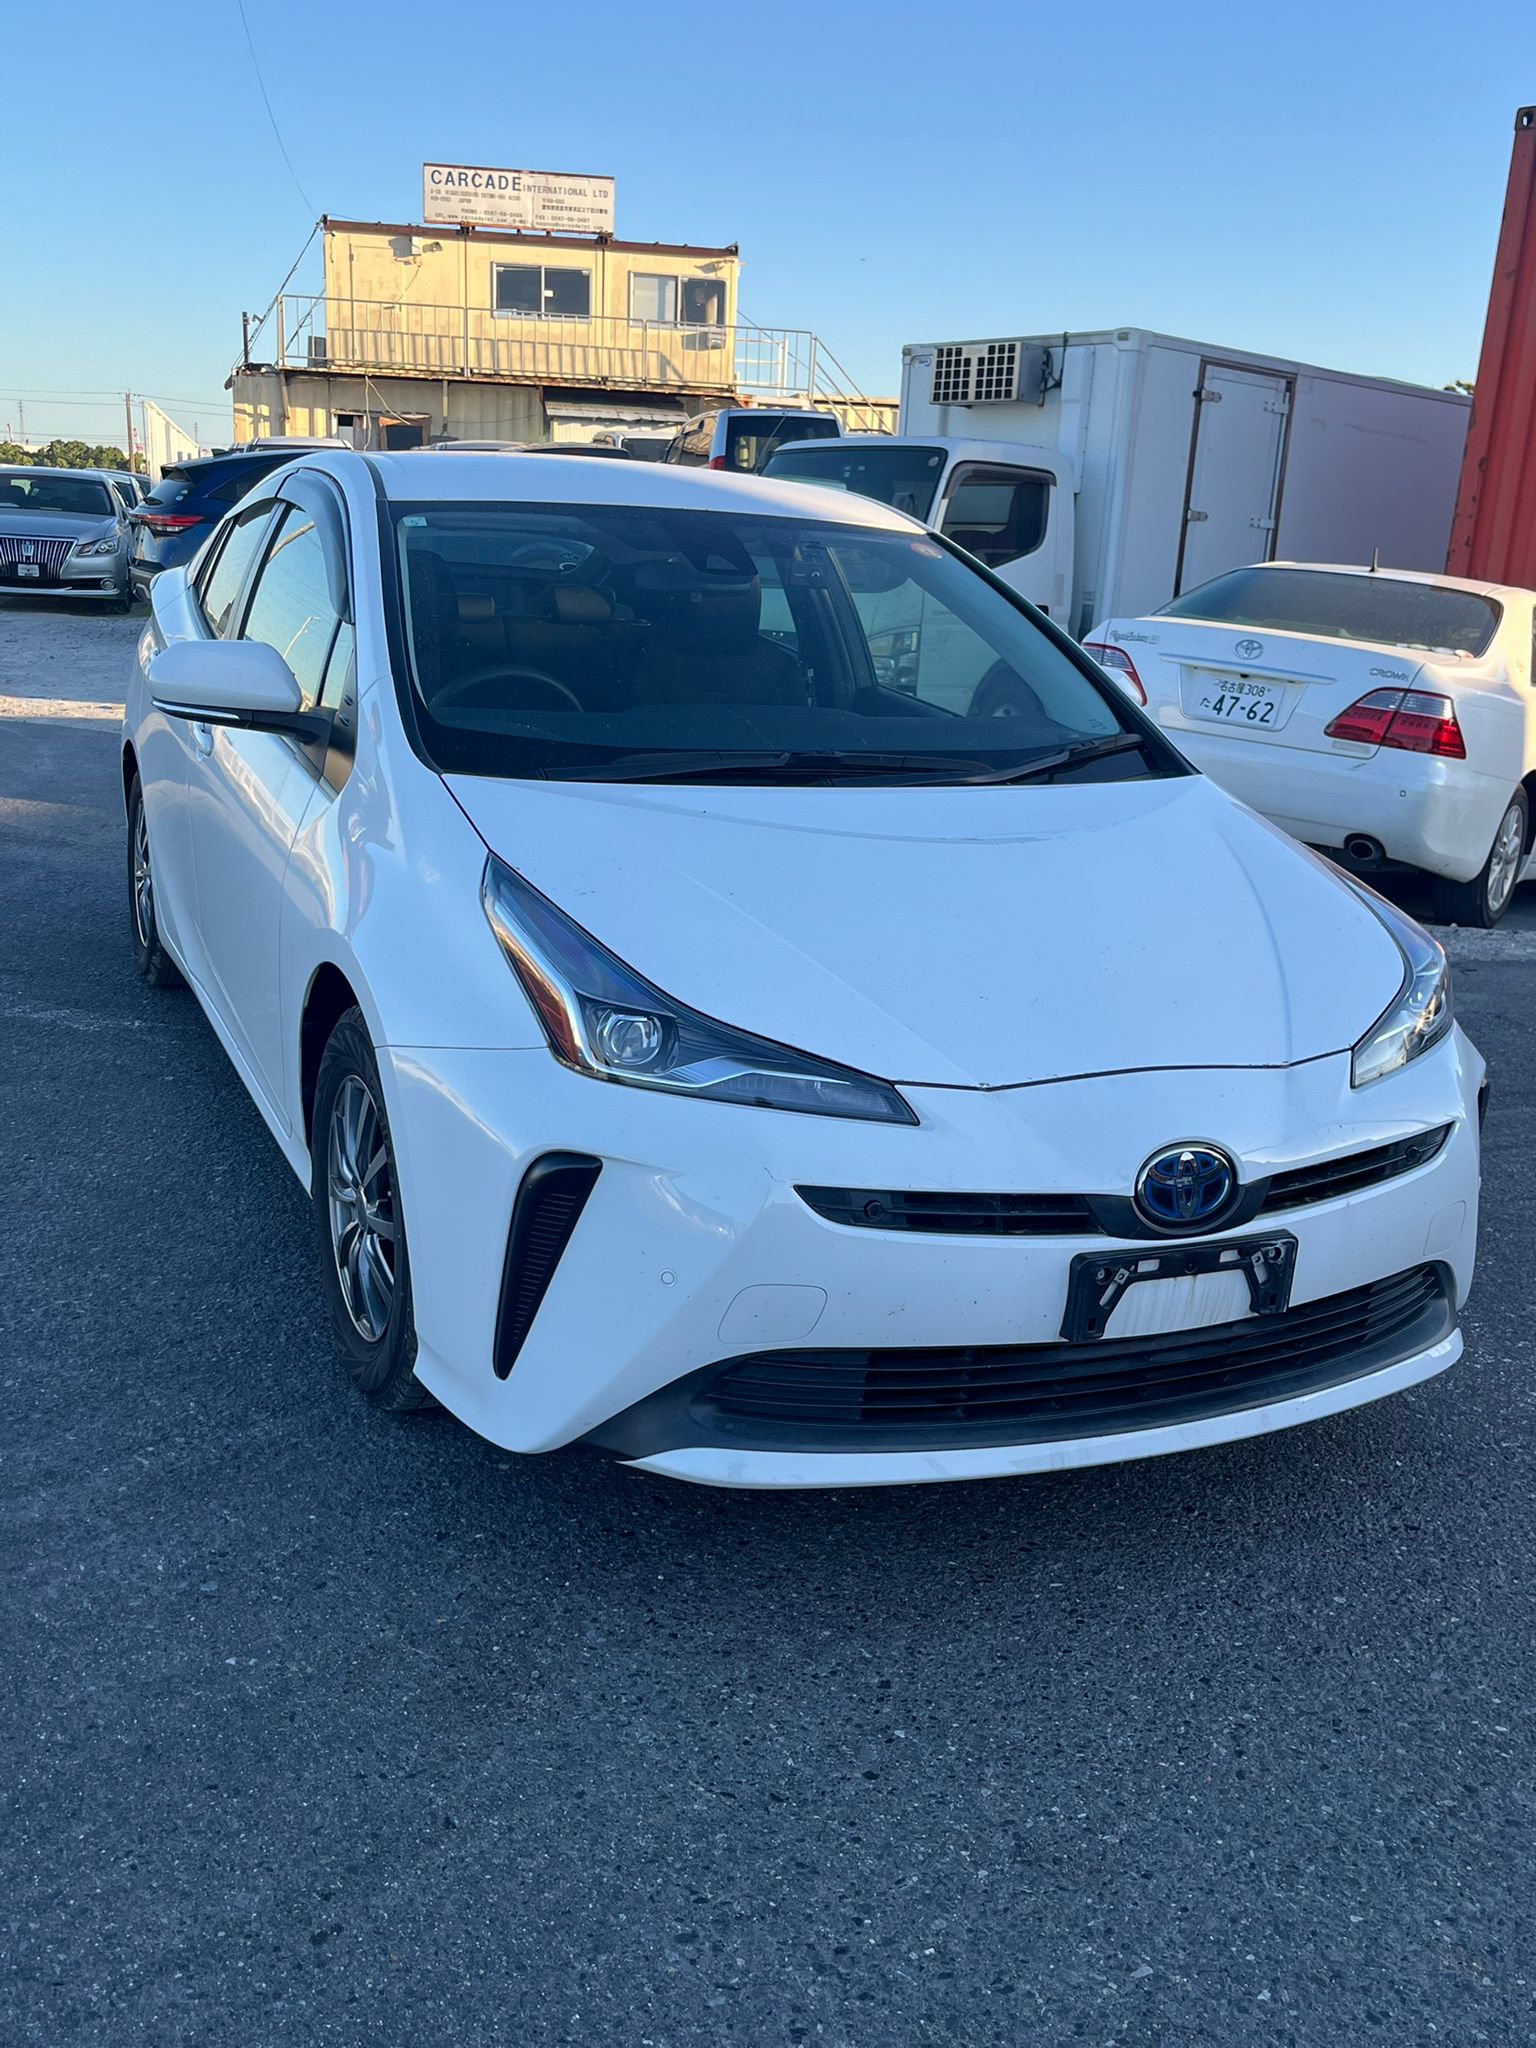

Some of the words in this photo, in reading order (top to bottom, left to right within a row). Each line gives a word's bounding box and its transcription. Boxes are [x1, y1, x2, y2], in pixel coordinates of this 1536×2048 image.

[430, 169, 522, 192] CARCADE
[522, 184, 588, 198] INTERNATIONAL
[592, 189, 609, 199] LTD
[1369, 667, 1409, 681] CROWN
[1212, 694, 1275, 723] 47-62
